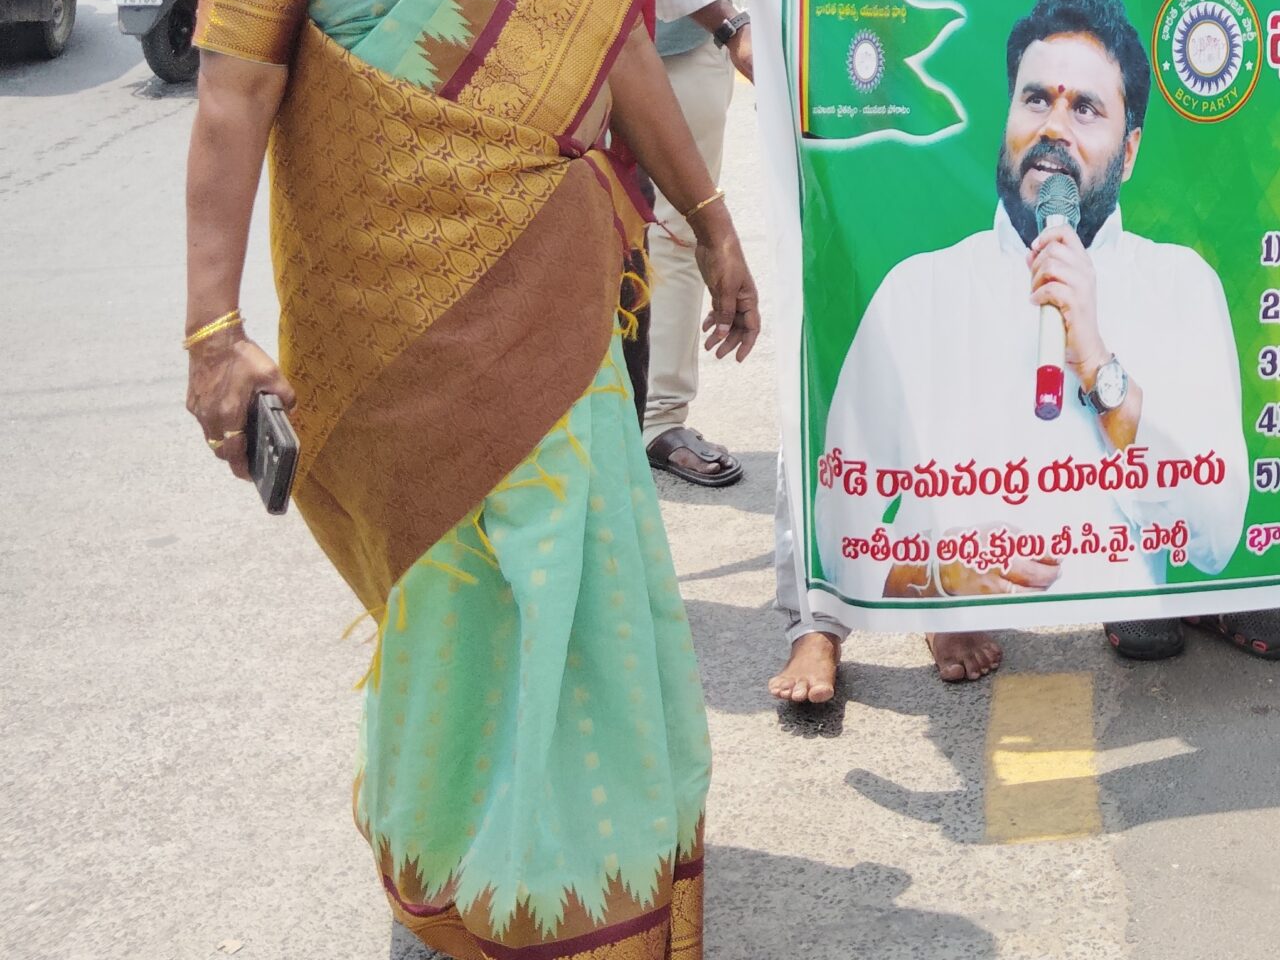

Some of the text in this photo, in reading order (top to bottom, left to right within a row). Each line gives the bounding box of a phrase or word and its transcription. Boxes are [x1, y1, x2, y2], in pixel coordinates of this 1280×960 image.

[1162, 7, 1179, 41] భారత
[1174, 86, 1239, 113] BCY PARTY
[818, 447, 1226, 506] బోడె రామచంద్ర యాదవ్ గారు
[1255, 461, 1280, 489] 5)
[842, 524, 931, 561] జాతీయ
[936, 524, 1046, 572] అధ్యక్షులు
[1142, 520, 1189, 563] పార్టీ
